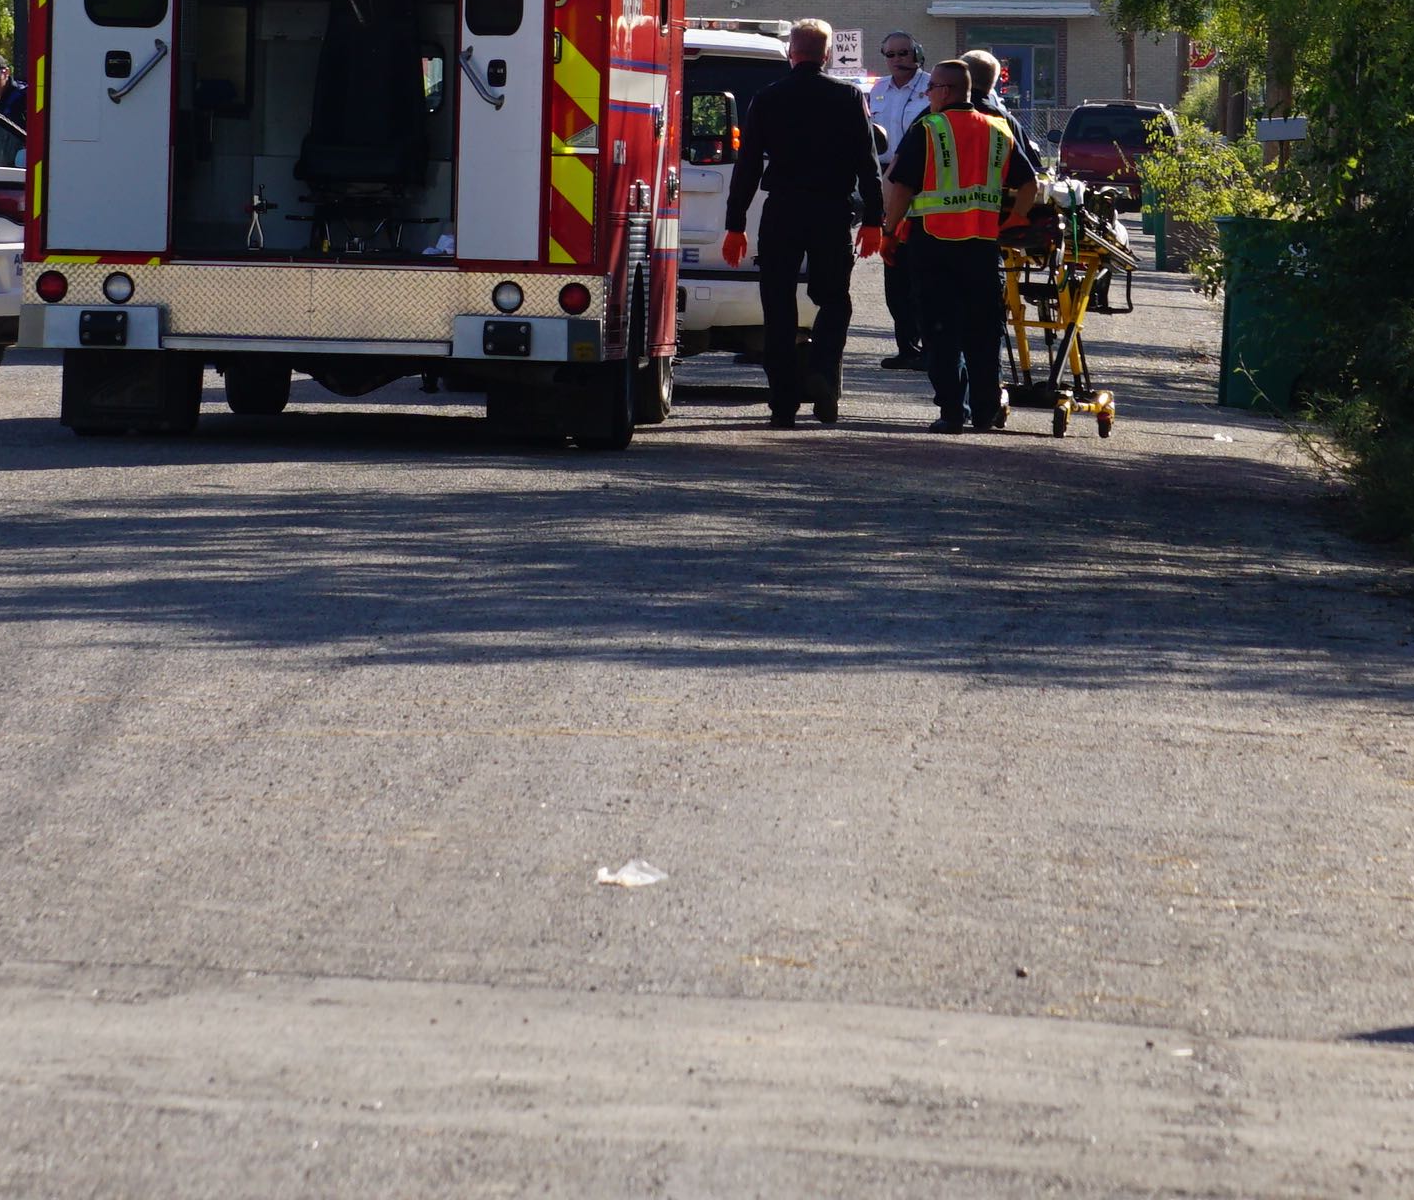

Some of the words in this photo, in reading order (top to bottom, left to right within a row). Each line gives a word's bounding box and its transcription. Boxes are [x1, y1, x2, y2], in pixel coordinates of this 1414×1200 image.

[836, 33, 858, 42] ONE
[836, 43, 858, 52] WAY
[939, 132, 951, 168] FIRE
[943, 195, 967, 206] SAN
